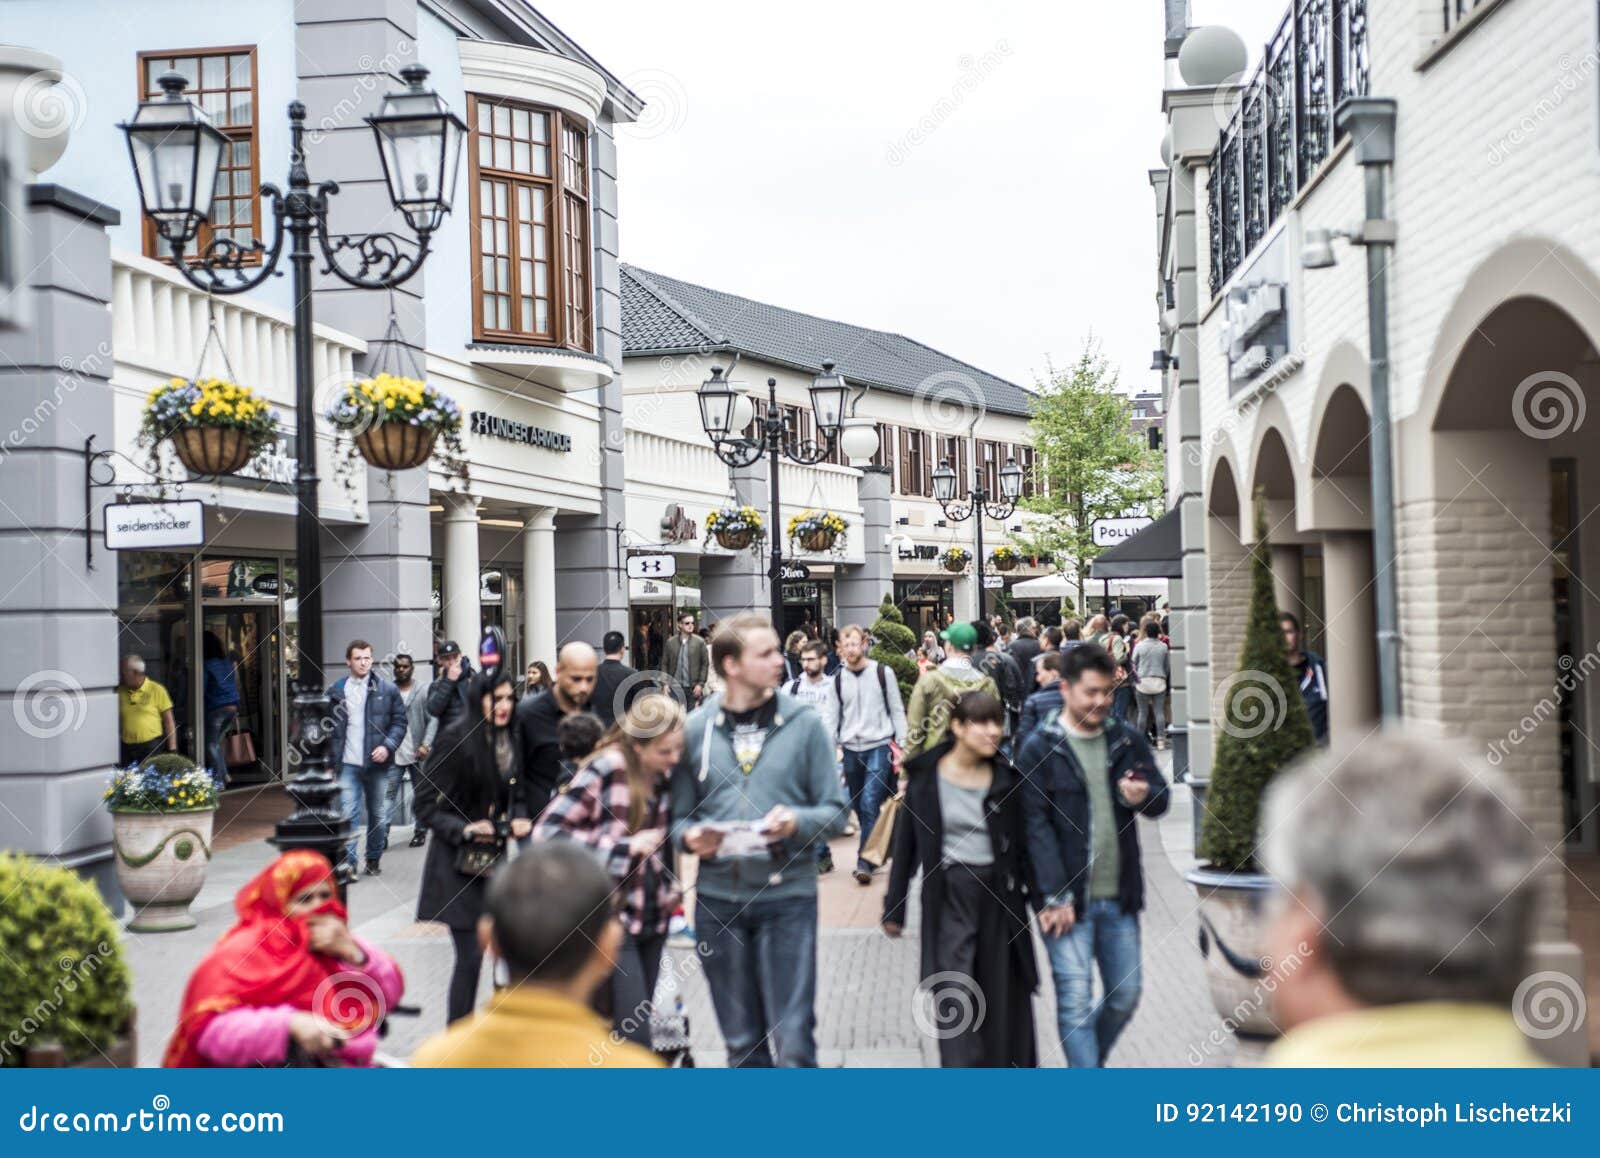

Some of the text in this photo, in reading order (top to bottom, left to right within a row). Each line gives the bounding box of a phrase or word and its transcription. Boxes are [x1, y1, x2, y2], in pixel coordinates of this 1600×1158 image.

[489, 416, 571, 452] UNDER ARMOUR
[117, 518, 191, 532] seidensticker
[1100, 527, 1140, 539] POLLI
